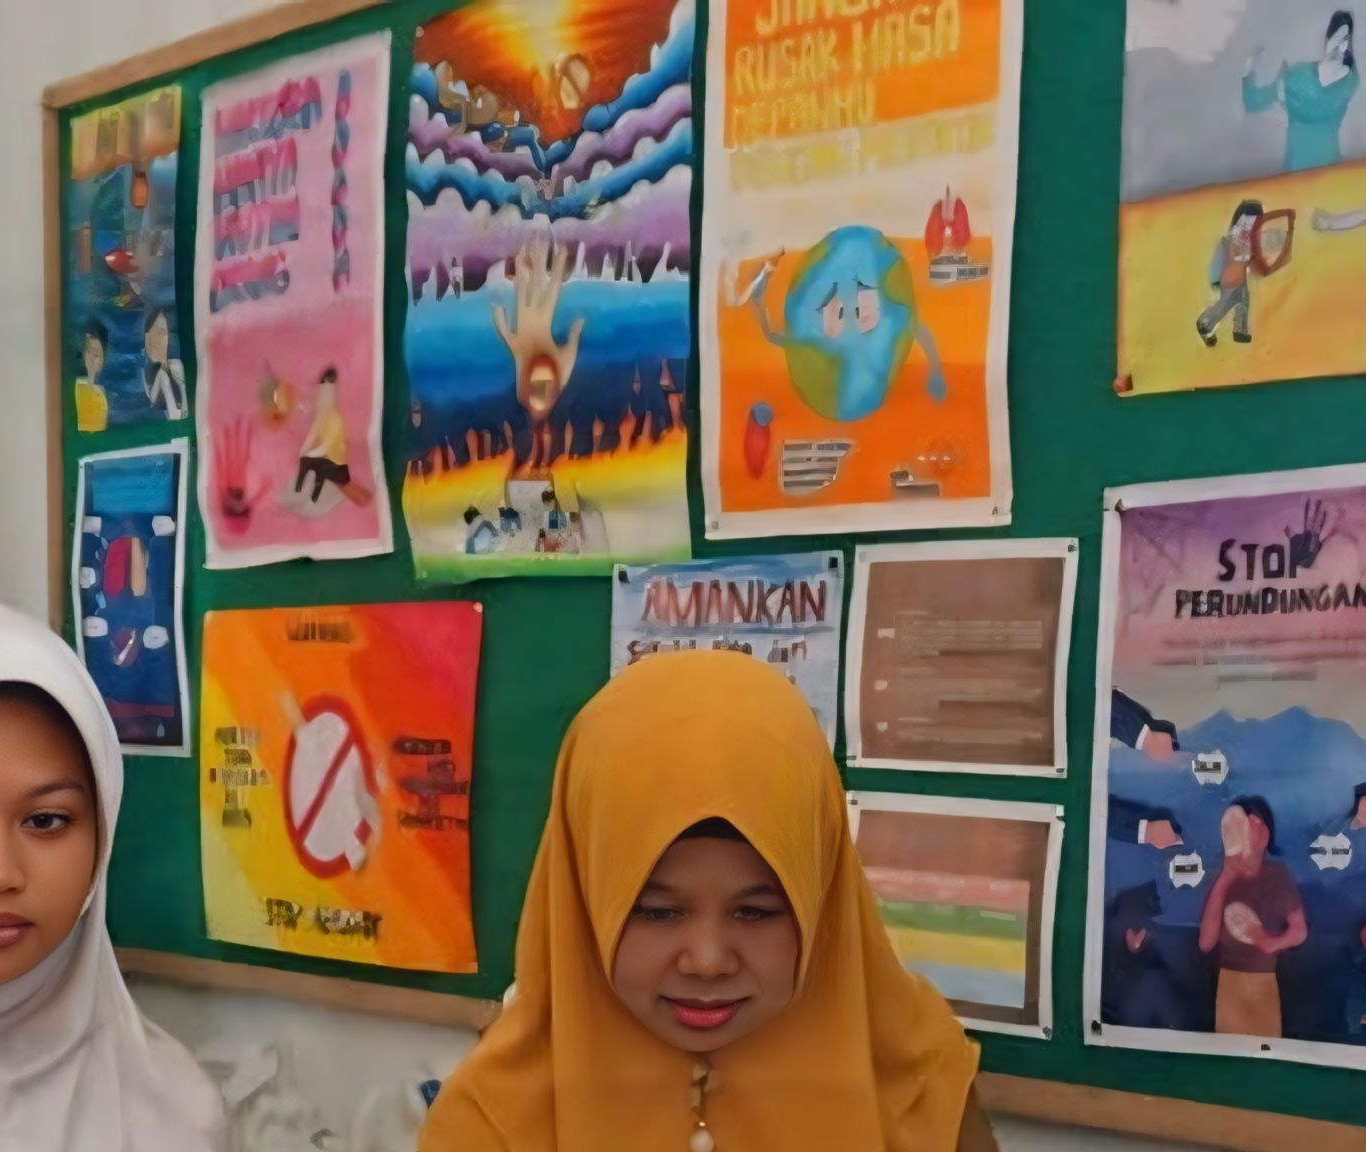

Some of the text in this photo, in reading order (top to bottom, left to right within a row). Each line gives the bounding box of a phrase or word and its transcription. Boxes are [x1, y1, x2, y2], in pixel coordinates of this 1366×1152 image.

[734, 27, 841, 96] RUSAK
[1216, 536, 1322, 583] STOP
[641, 577, 827, 626] AMANKAN
